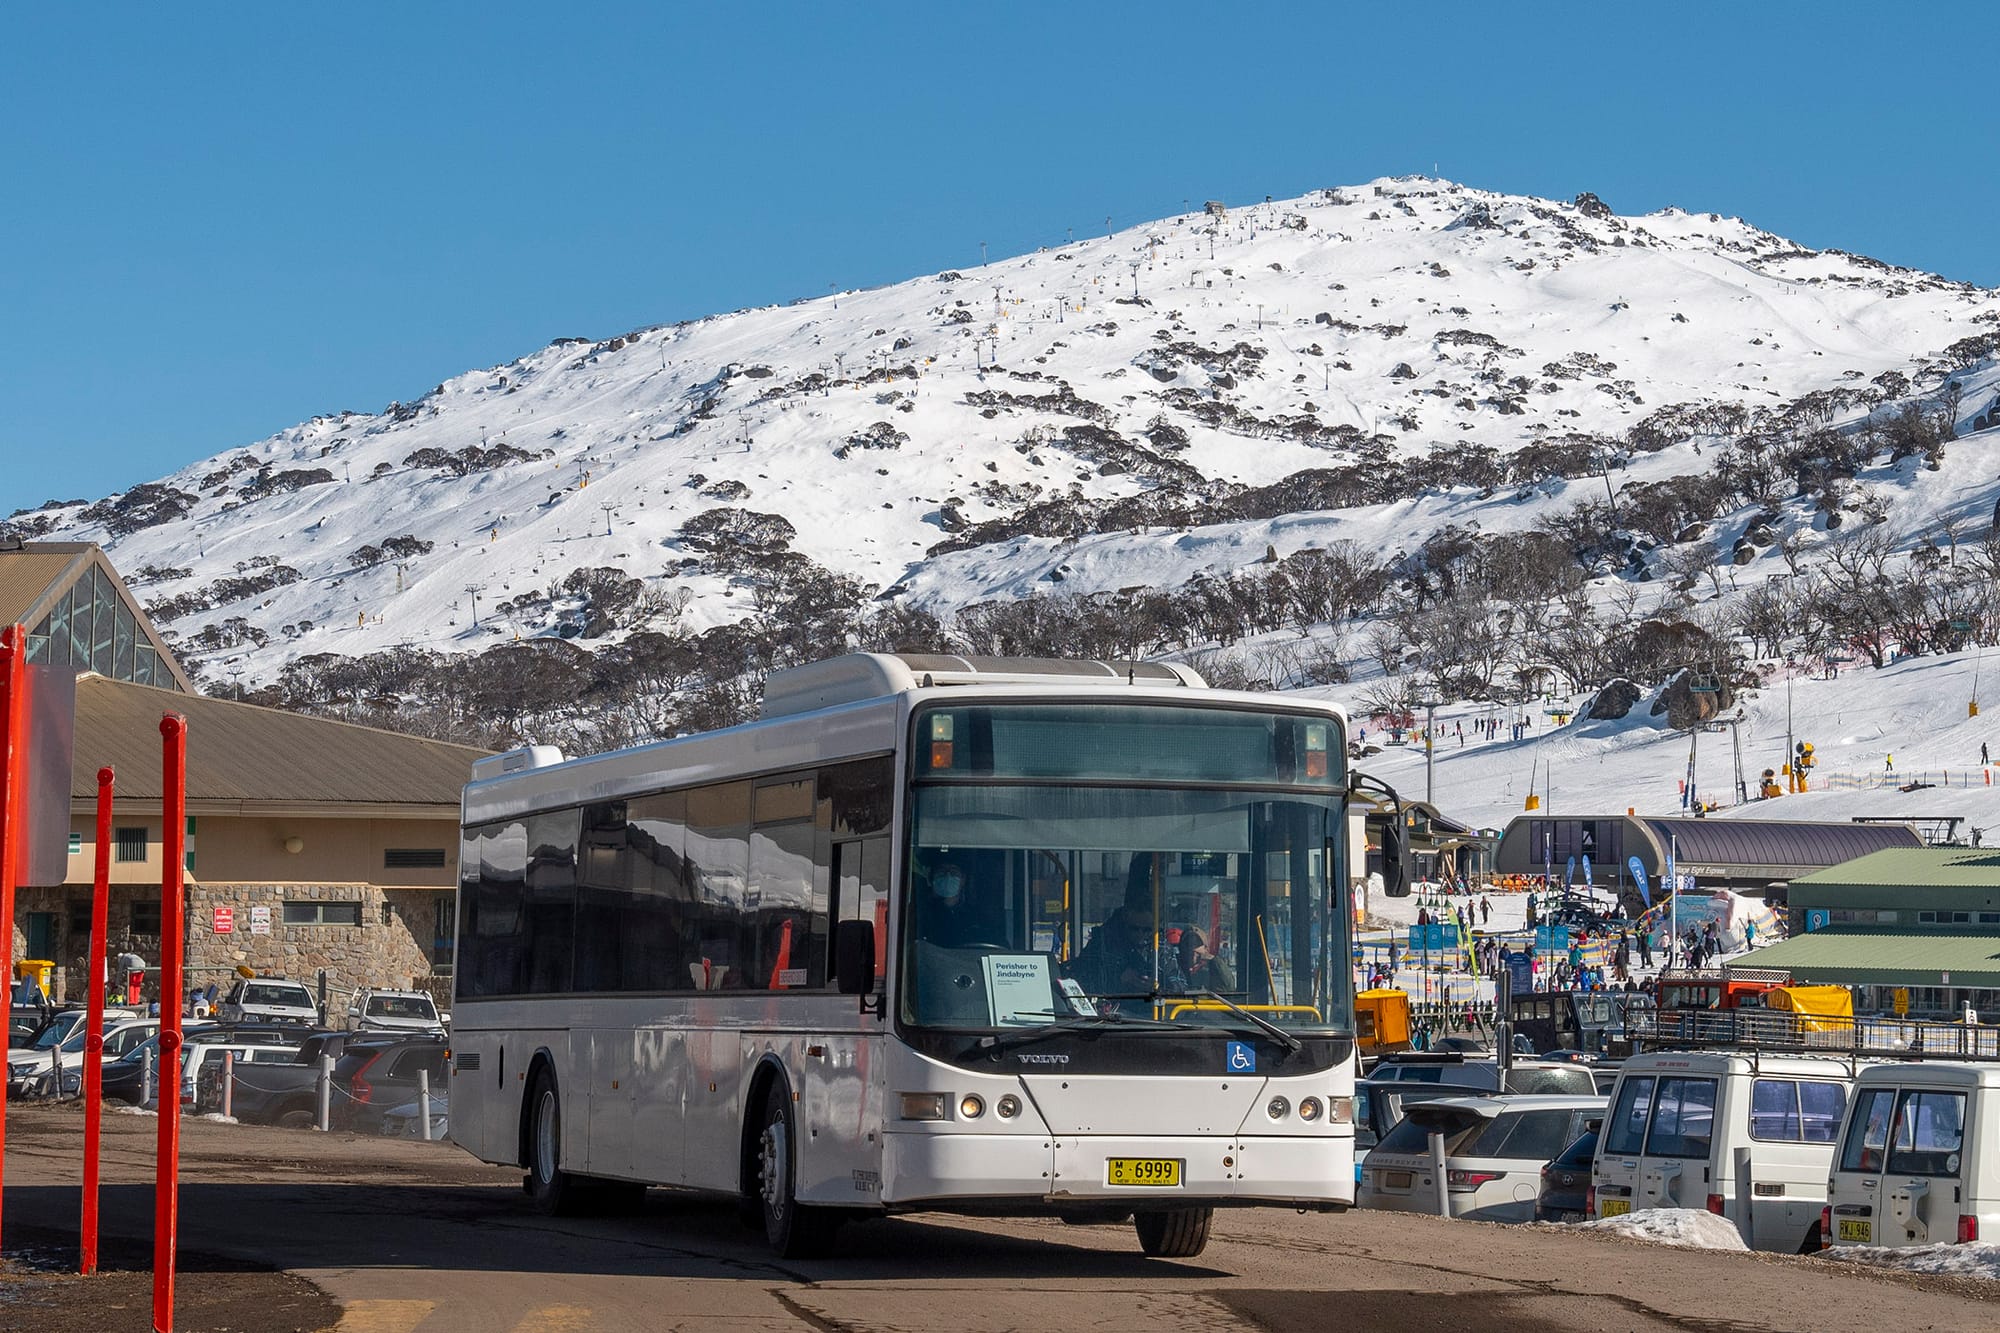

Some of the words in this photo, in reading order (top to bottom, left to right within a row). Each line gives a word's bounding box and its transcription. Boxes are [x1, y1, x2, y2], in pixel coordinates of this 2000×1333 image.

[997, 971, 1035, 979] Jindabyne
[1017, 1054, 1070, 1064] VOLVO
[1135, 1161, 1172, 1179] 6999
